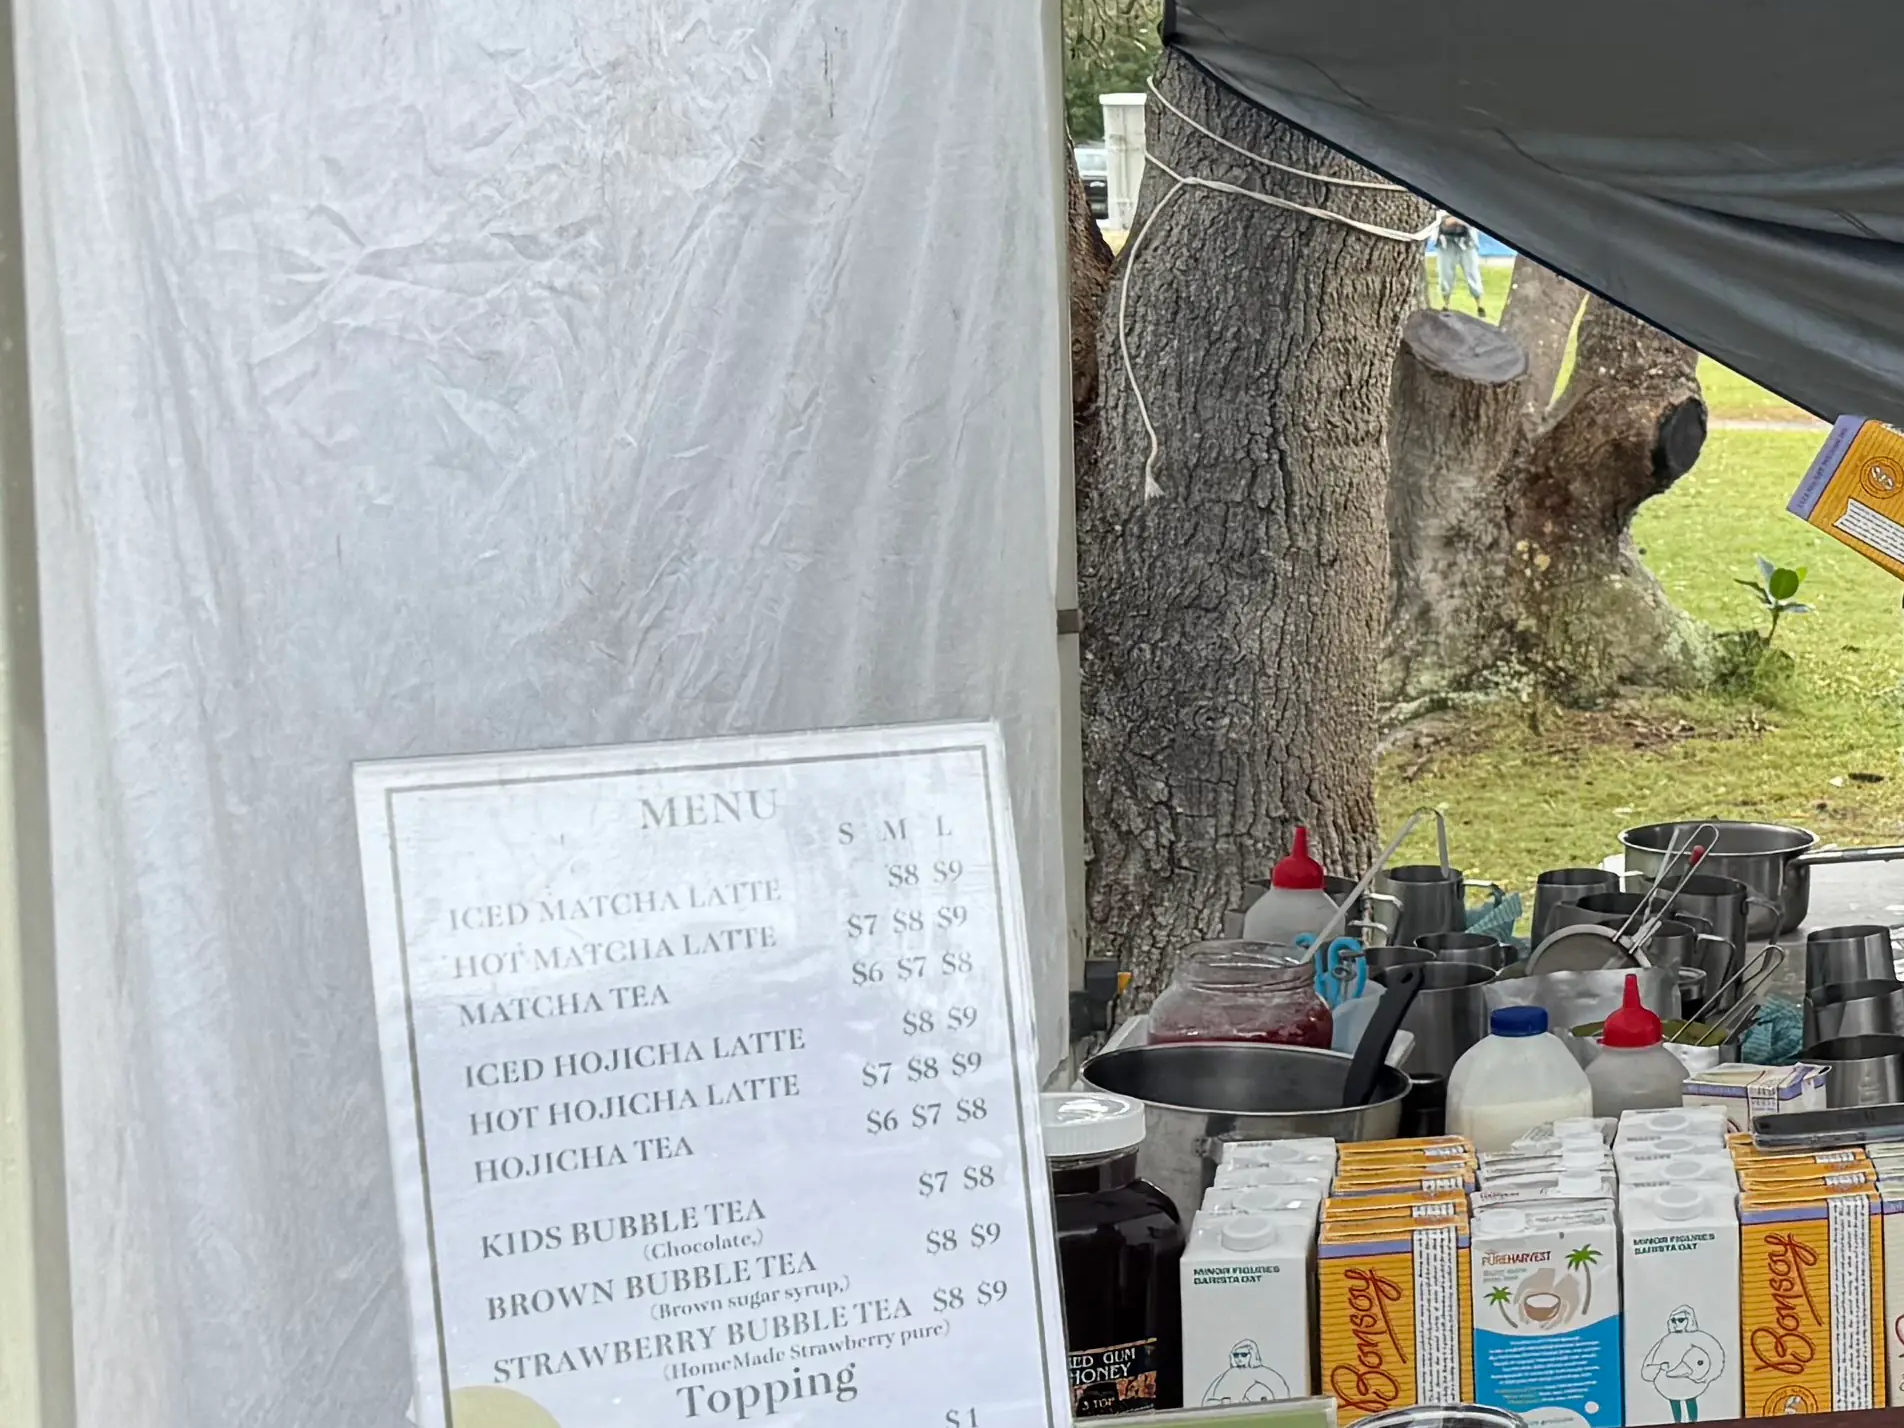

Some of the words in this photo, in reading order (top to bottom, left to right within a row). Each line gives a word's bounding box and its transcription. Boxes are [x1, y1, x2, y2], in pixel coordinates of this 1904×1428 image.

[640, 789, 779, 831] MENU
[839, 822, 854, 844] S
[882, 819, 908, 841] M
[937, 815, 952, 838] L
[449, 903, 529, 932] ICED
[538, 889, 679, 923] MATCHA
[689, 879, 782, 910] LATTE
[889, 863, 919, 888] $8
[933, 860, 963, 884] $9
[454, 951, 521, 979] HOT
[534, 937, 672, 972] MATCHA
[683, 925, 776, 957] LATTE
[847, 914, 877, 939] $7
[893, 909, 923, 934] $8
[937, 905, 968, 929] $9
[459, 991, 602, 1028] MATCHA
[609, 985, 671, 1012] TEA
[852, 962, 883, 986] $6
[897, 956, 927, 981] $7
[942, 952, 972, 975] $8
[464, 1059, 544, 1089] ICED
[554, 1041, 704, 1080] HOJICHA
[713, 1028, 805, 1059] LATTE
[903, 1012, 934, 1036] $8
[947, 1007, 978, 1032] $9
[469, 1107, 538, 1136] HOT
[548, 1090, 698, 1127] HOJICHA
[707, 1075, 800, 1107] LATTE
[862, 1063, 892, 1088] $7
[907, 1058, 938, 1083] $8
[952, 1052, 983, 1076] $9
[474, 1145, 626, 1184] HOJICHA
[633, 1137, 693, 1166] TEA
[866, 1110, 898, 1134] $6
[911, 1104, 941, 1128] $7
[956, 1098, 987, 1122] $8
[481, 1226, 562, 1260] KIDS
[571, 1207, 699, 1248] BUBBLE
[704, 1198, 766, 1227] TEA
[918, 1171, 949, 1197] $7
[963, 1165, 995, 1191] $8
[487, 1282, 614, 1321] BROWN
[625, 1260, 751, 1301] BUBBLE
[755, 1250, 817, 1280] TEA
[925, 1230, 958, 1255] $8
[969, 1222, 1002, 1248] $9
[649, 1298, 723, 1323] (Brown
[728, 1289, 781, 1312] sugar
[1750, 1233, 1823, 1374] Bonsoy
[492, 1327, 716, 1386] STRAWBERRY
[726, 1305, 849, 1347] BUBBLE
[853, 1296, 913, 1327] TEA
[932, 1287, 965, 1314] $8
[975, 1280, 1009, 1307] $9
[790, 1329, 895, 1362] Strawberry
[899, 1320, 950, 1347] pure)
[1330, 1267, 1408, 1413] Bonsoy
[676, 1362, 859, 1420] Topping
